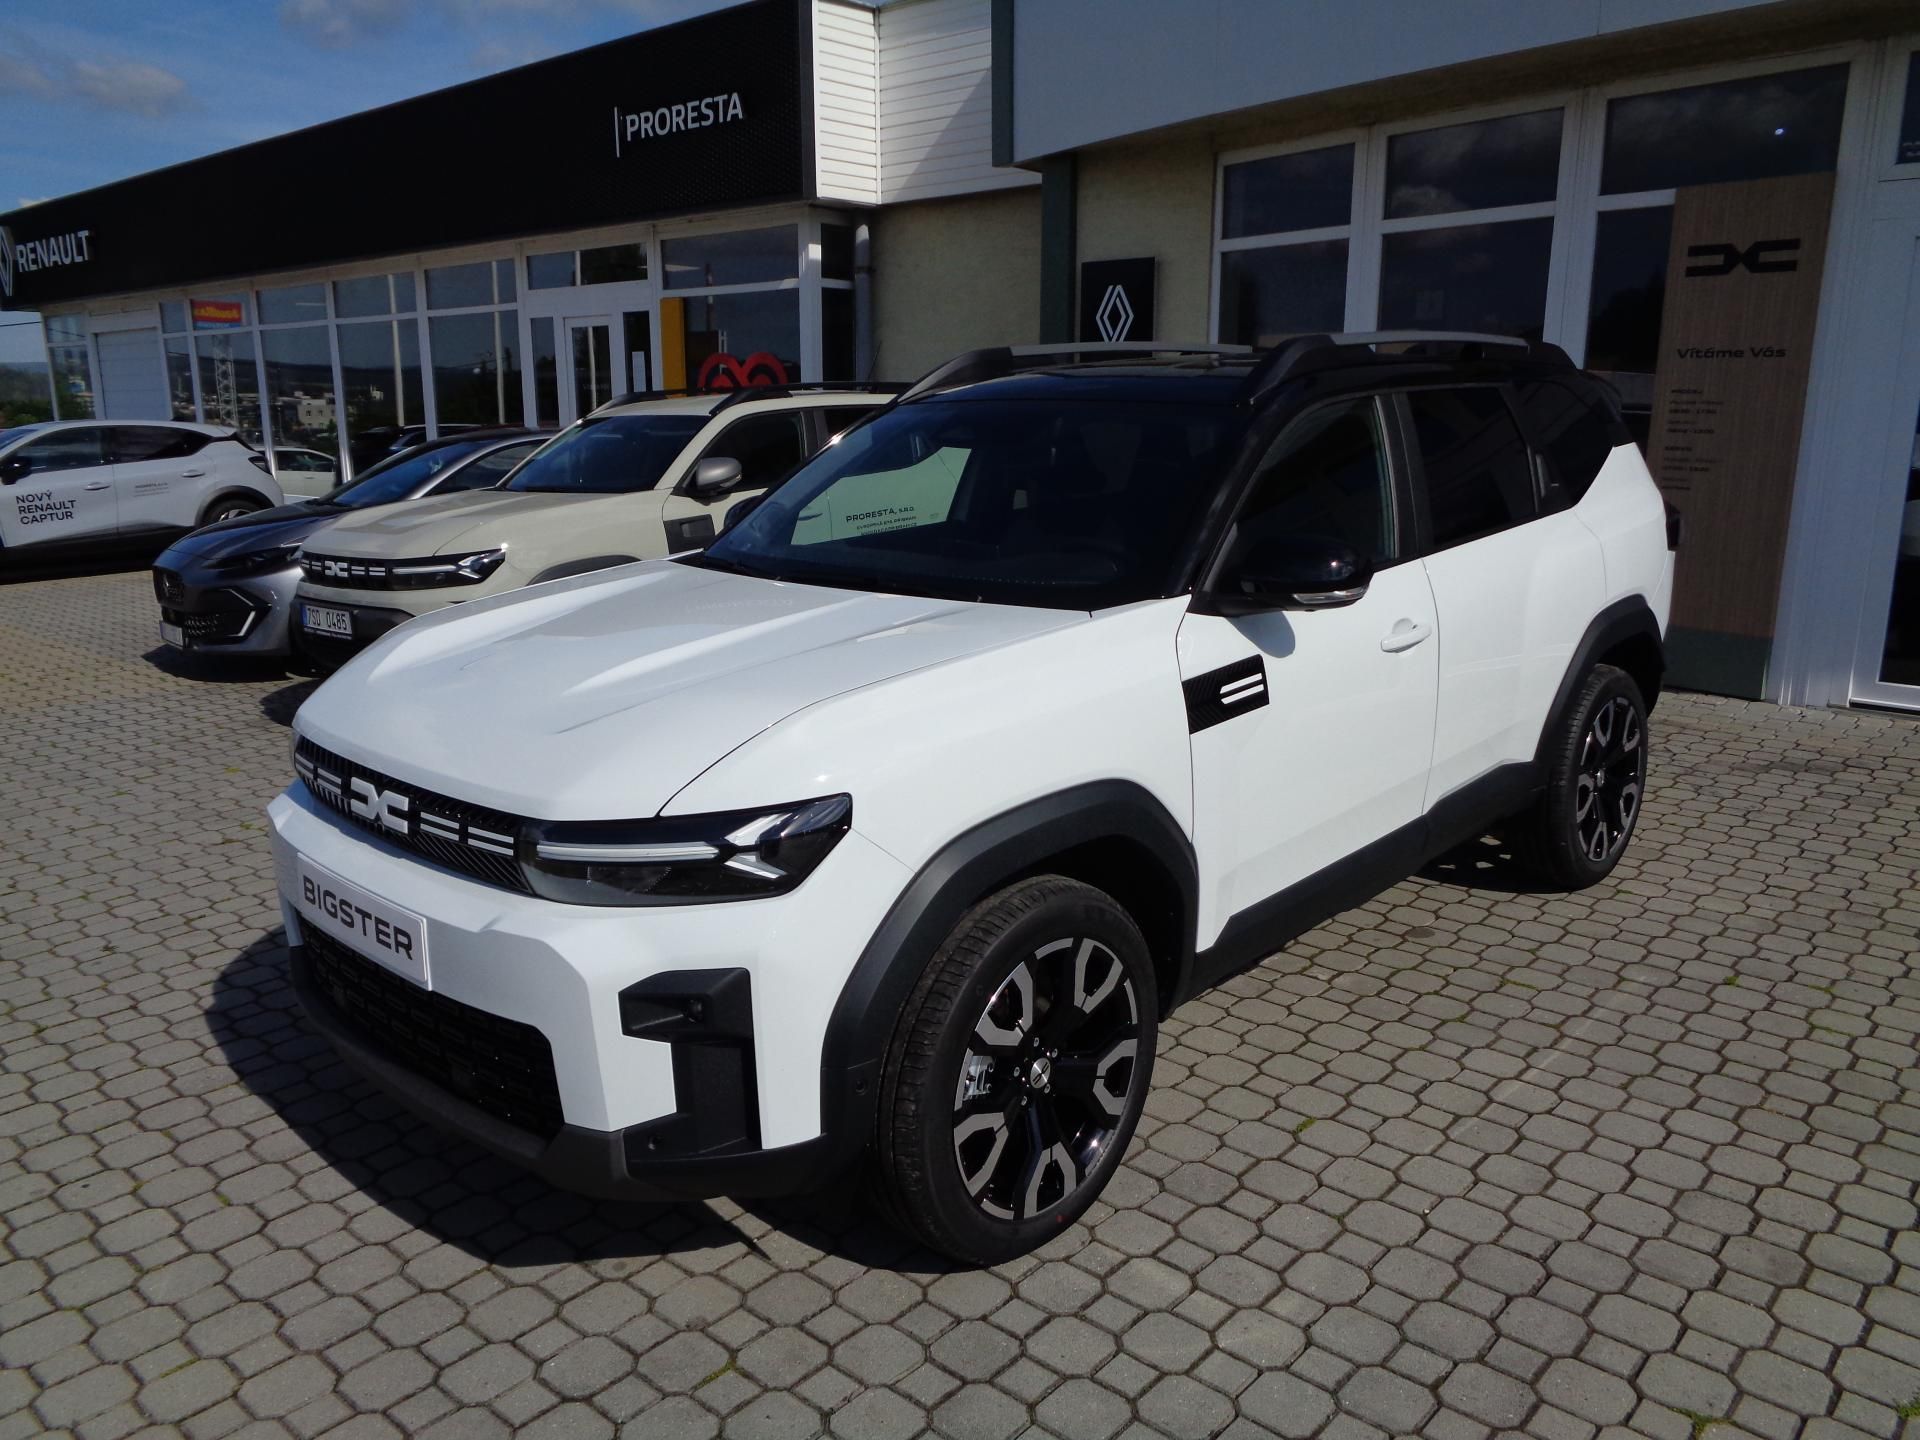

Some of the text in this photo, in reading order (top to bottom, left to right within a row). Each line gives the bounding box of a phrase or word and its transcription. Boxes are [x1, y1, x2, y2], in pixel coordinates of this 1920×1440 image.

[626, 92, 743, 141] PRORESTA
[15, 229, 90, 273] RENAULT
[1677, 346, 1787, 359] Vítáme Vás
[16, 489, 52, 504] NOVÝ
[18, 500, 76, 515] RENAULT
[20, 511, 74, 525] CAPTUR
[302, 874, 413, 961] BIGSTER
